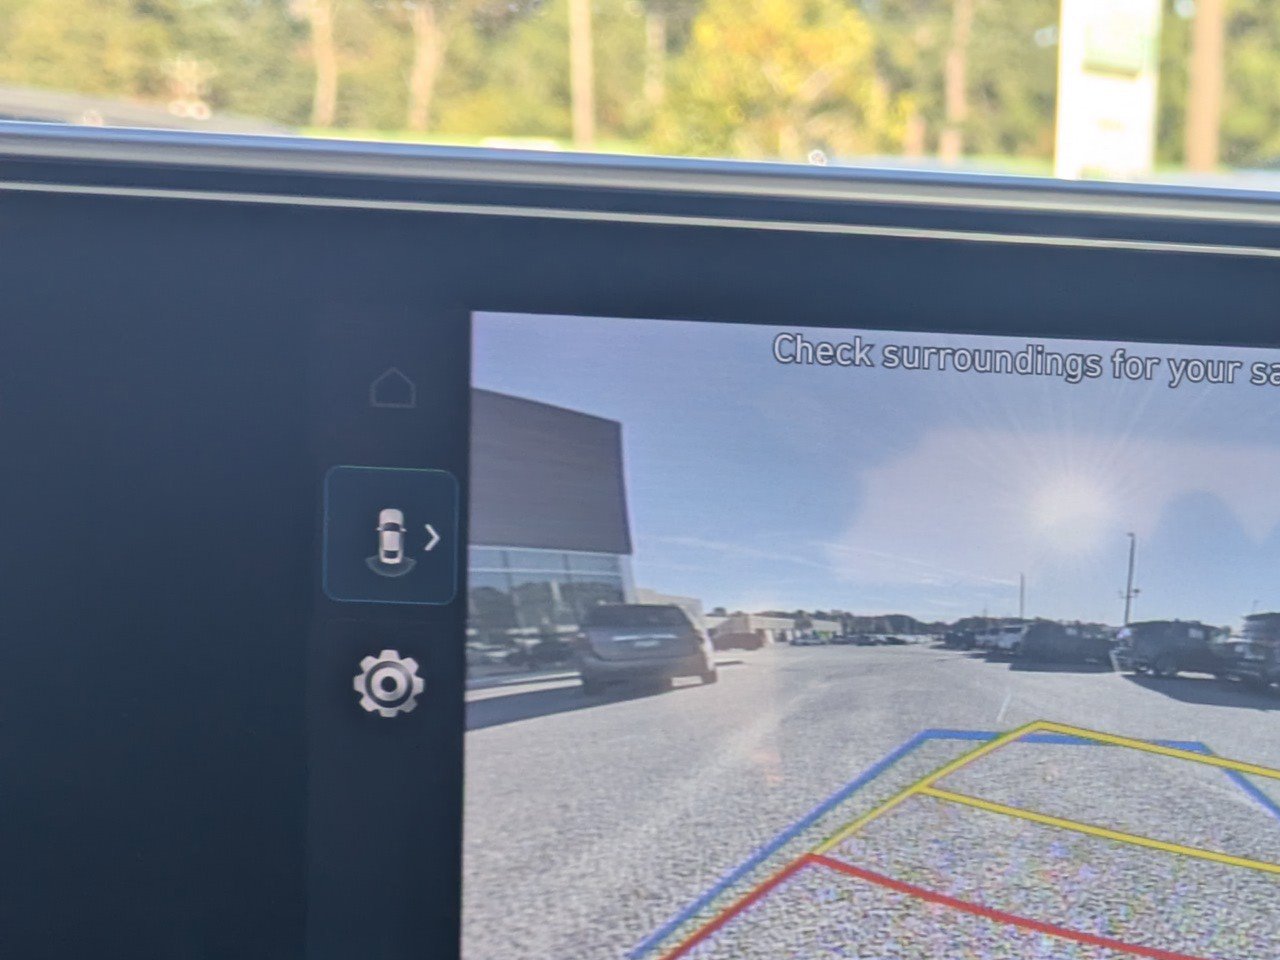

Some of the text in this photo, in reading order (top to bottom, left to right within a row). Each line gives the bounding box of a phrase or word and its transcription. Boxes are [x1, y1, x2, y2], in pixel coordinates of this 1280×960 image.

[771, 332, 875, 369] Check
[881, 340, 1102, 385] surroundings
[1112, 348, 1160, 381] for
[1168, 354, 1242, 389] your
